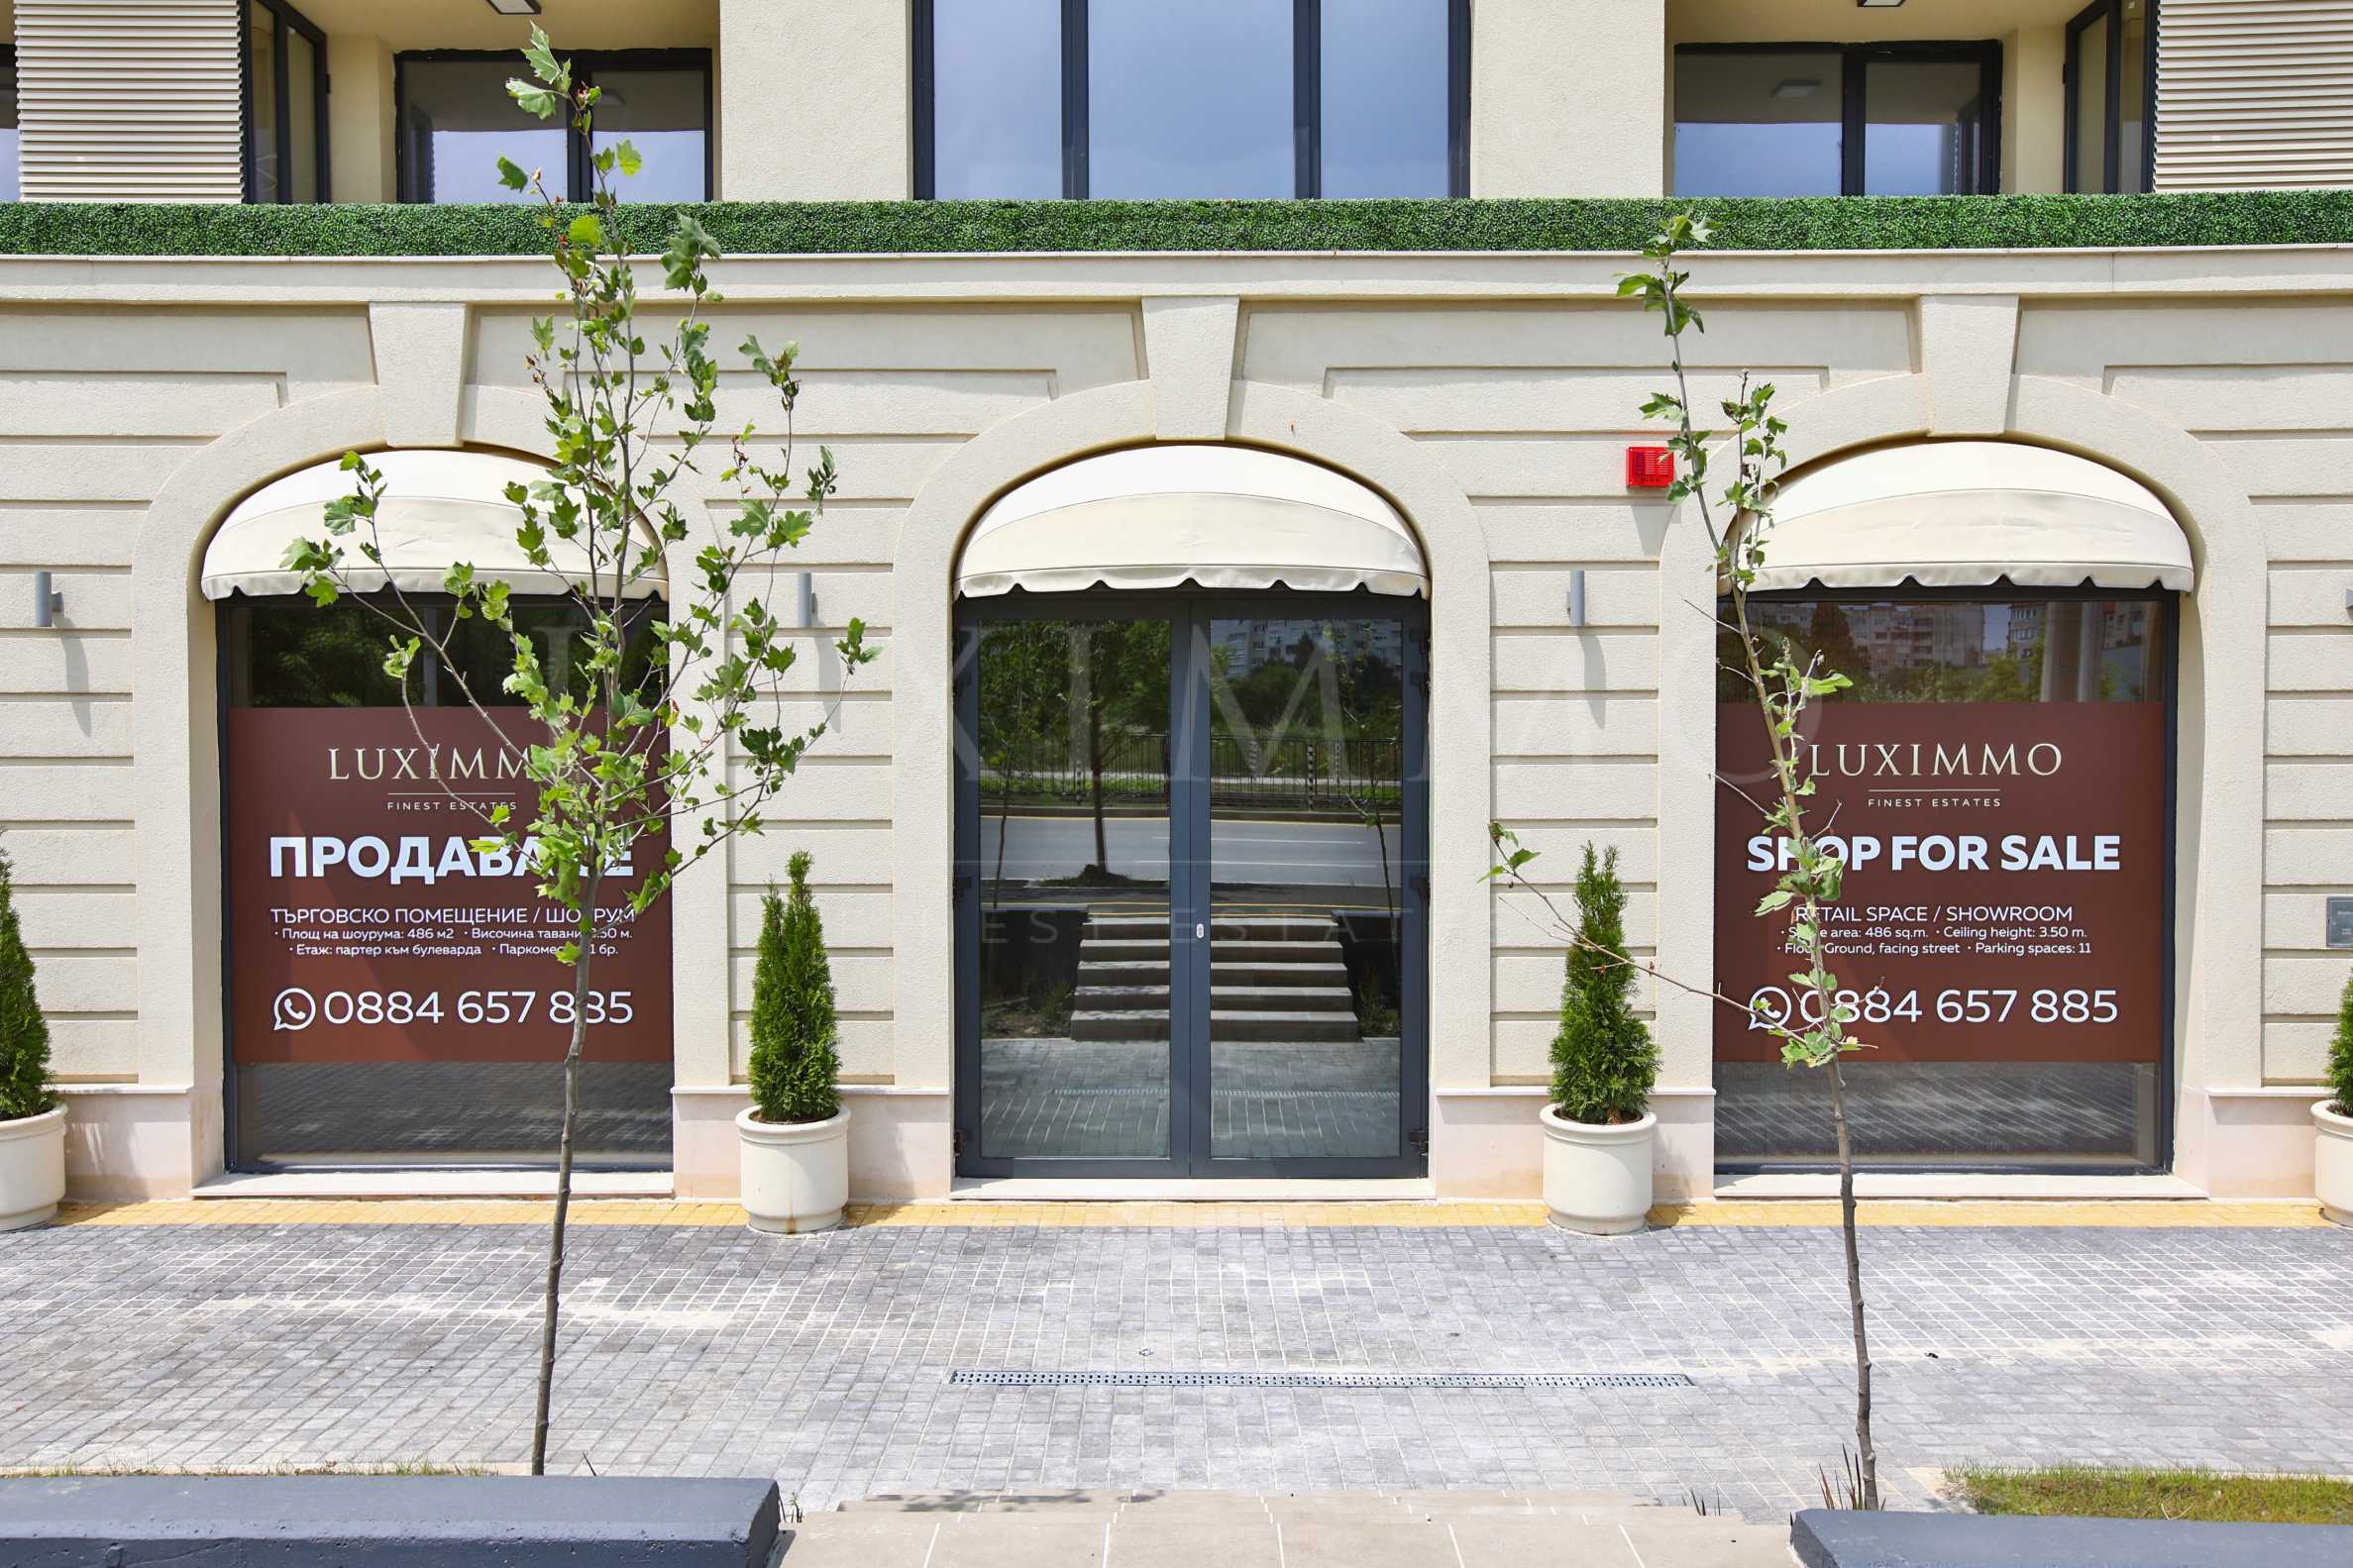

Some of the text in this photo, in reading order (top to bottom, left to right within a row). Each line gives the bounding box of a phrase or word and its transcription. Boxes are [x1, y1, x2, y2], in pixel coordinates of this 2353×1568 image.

[328, 746, 574, 781] LUXIMM
[1809, 743, 2062, 777] LUXIMMO
[387, 801, 441, 810] FINEST
[1868, 798, 2001, 807] FINEST ESTATES
[1748, 835, 2120, 871] SHOP FOR SALE
[269, 908, 390, 924] ТЪРГОВСКО
[395, 908, 527, 926] ПОМЕЩЕНИЕ
[546, 907, 635, 923] ШОРУМ
[1867, 906, 1928, 921] SPACE
[1946, 906, 2073, 921] SHOWROOM
[281, 928, 320, 940] Площ
[342, 931, 405, 942] шоурума:
[407, 928, 434, 939] 486
[437, 928, 455, 939] м2
[472, 928, 534, 939] Височина
[537, 930, 586, 939] тавани
[1865, 926, 1892, 937] 486
[1894, 929, 1929, 940] sq.m.
[1943, 926, 2087, 940] Ceiling height: 3.50 m.
[296, 945, 333, 955] Етаж:
[335, 947, 381, 957] партер
[412, 944, 481, 957] булеварда
[499, 943, 582, 957] Паркомес
[598, 943, 619, 957] бр.
[1824, 942, 1875, 955] Ground,
[1878, 942, 1919, 956] facing
[1922, 944, 1961, 954] street
[1975, 942, 2091, 956] Parking spaces: 11
[324, 991, 634, 1024] 0884 657 885
[1799, 989, 2118, 1023] 0884 657 885
